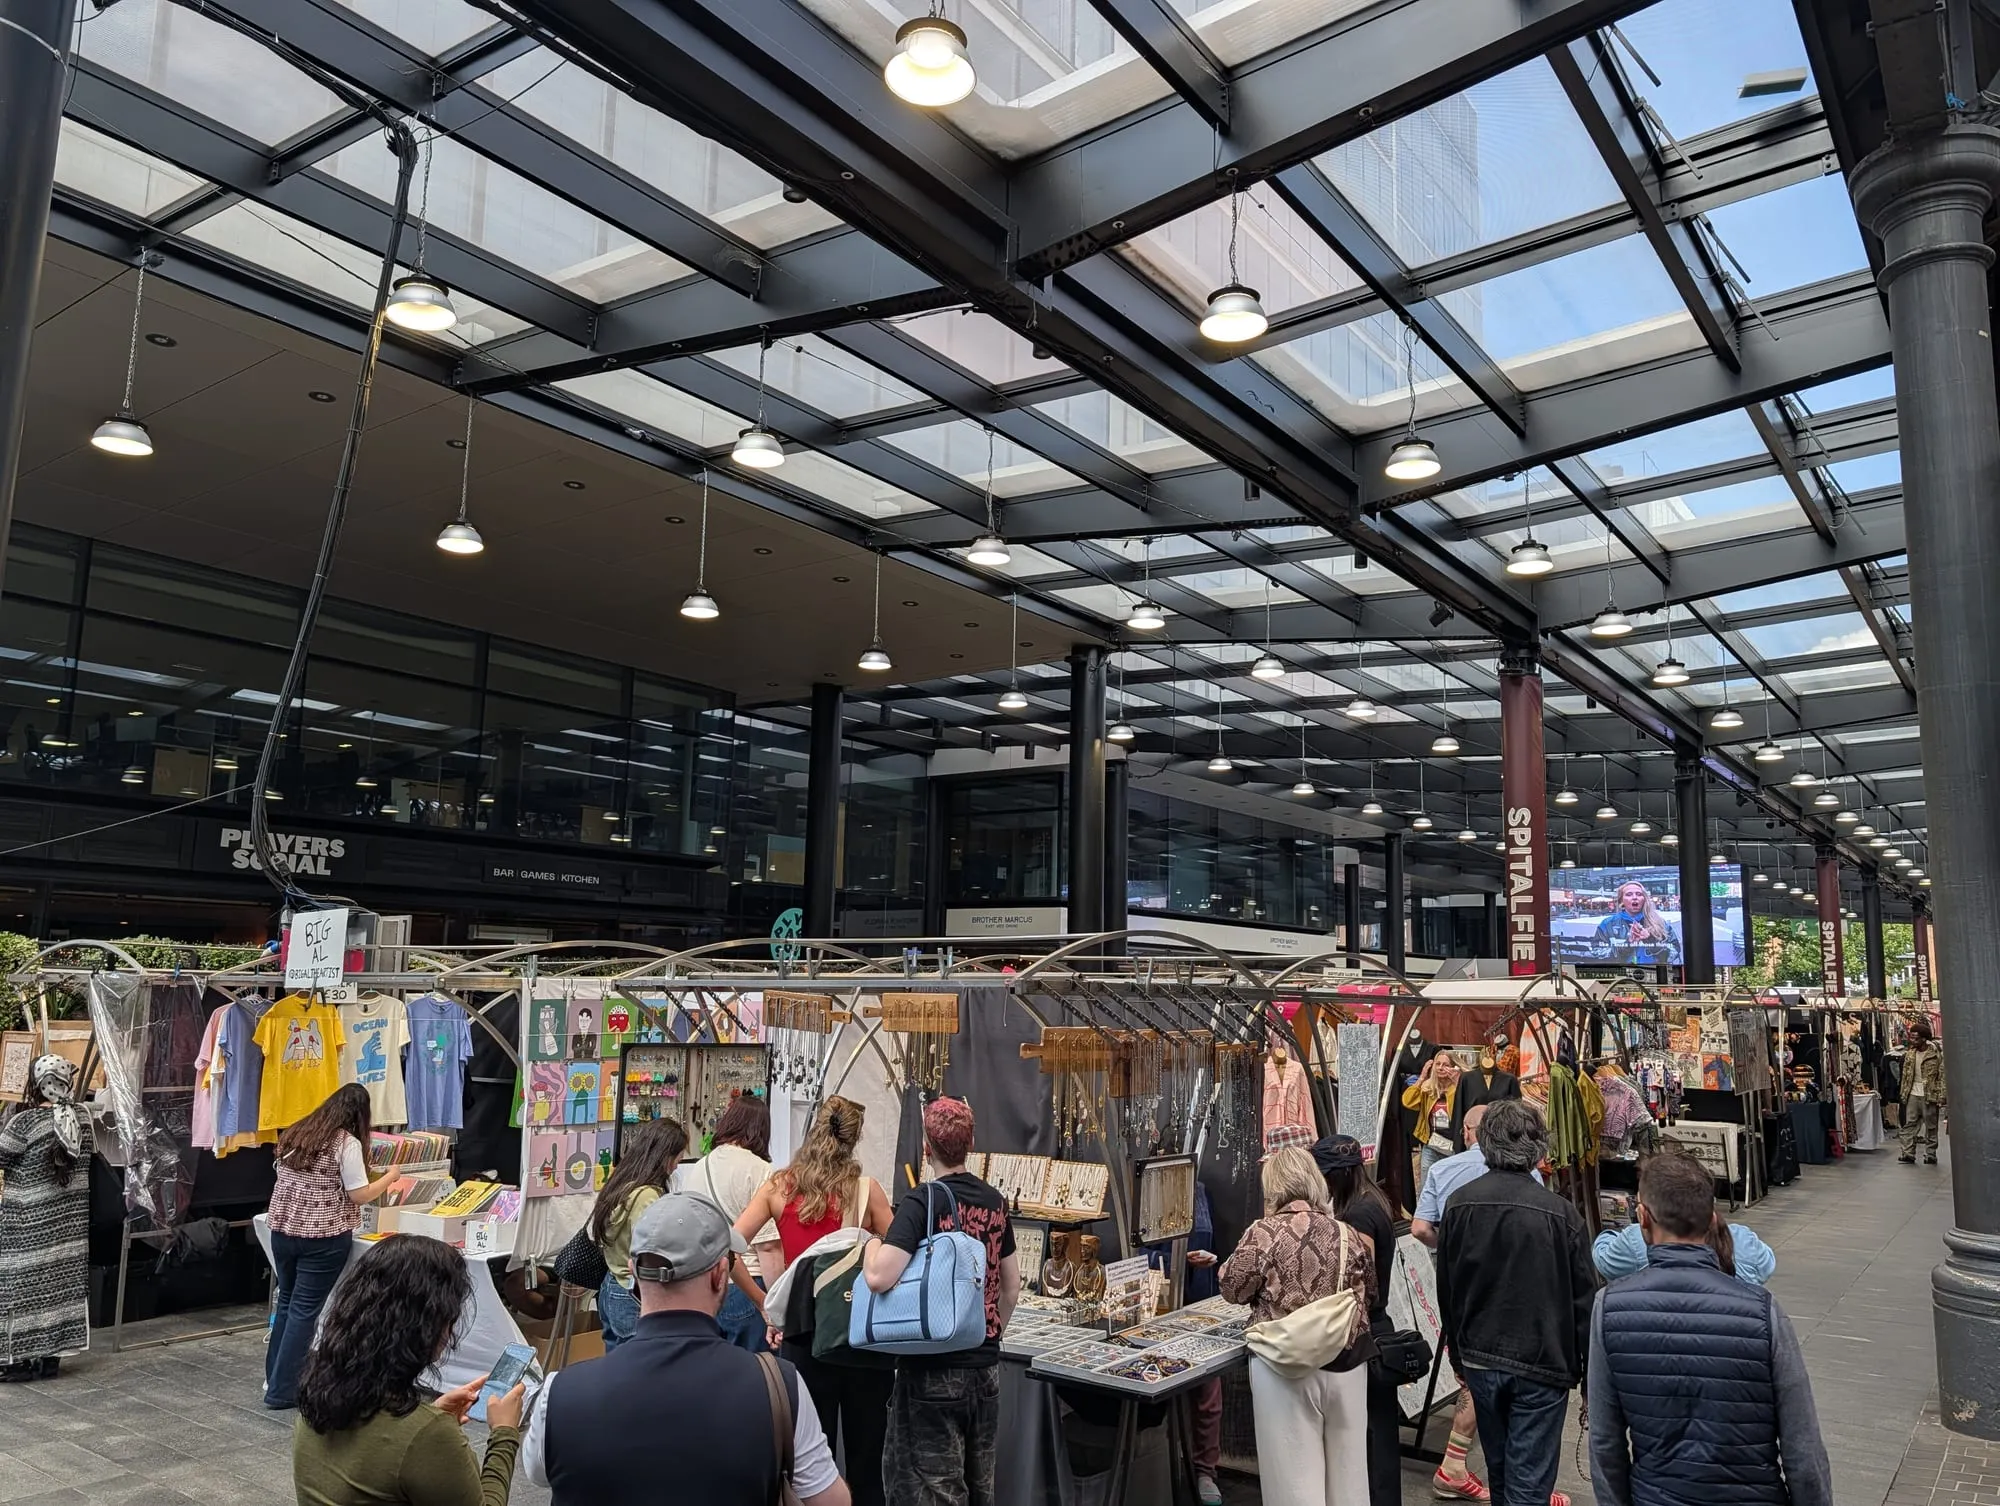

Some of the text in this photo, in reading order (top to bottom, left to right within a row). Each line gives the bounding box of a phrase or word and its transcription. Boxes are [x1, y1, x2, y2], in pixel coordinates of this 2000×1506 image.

[493, 868, 600, 884] BAR GAMES KITCHEN
[971, 916, 1033, 924] BROTHER MARCUS
[305, 918, 332, 947] BIG
[311, 945, 329, 964] AL
[324, 988, 348, 1000] £30
[352, 1018, 389, 1033] OCEAN
[475, 1231, 488, 1241] BIG
[476, 1241, 487, 1249] AL
[843, 1290, 853, 1302] S
